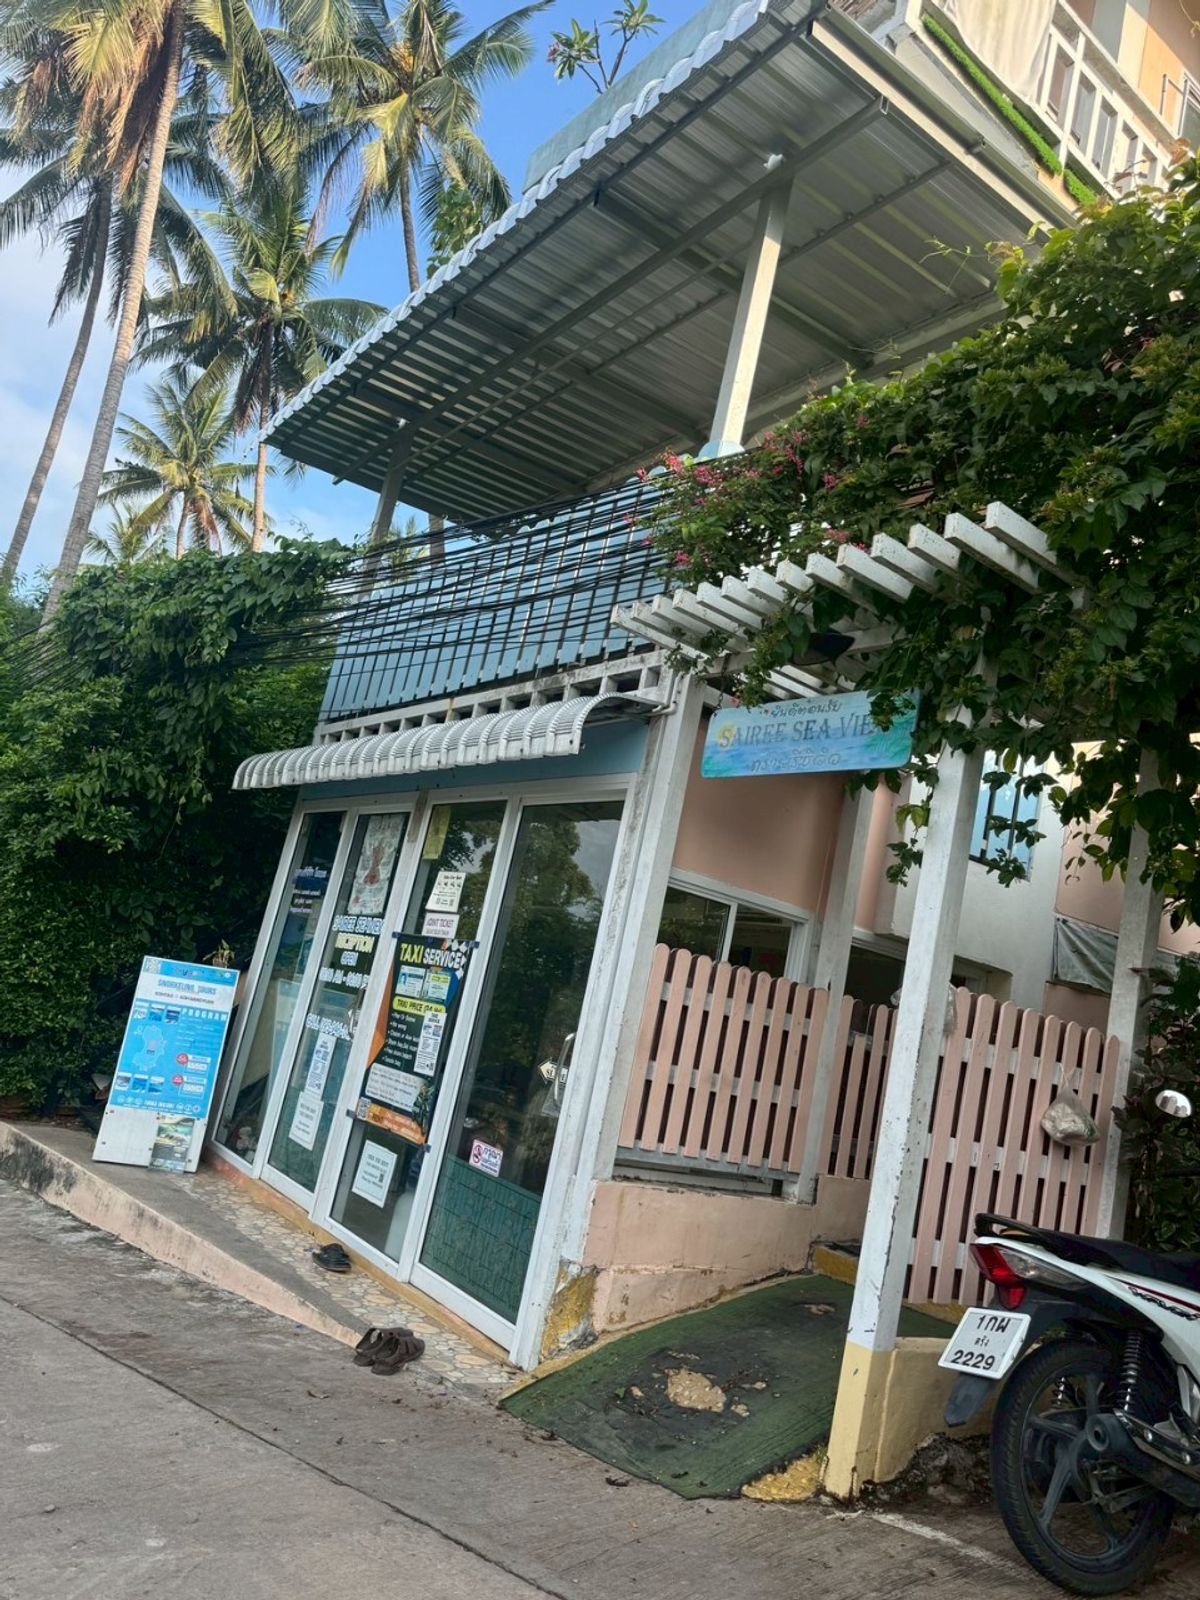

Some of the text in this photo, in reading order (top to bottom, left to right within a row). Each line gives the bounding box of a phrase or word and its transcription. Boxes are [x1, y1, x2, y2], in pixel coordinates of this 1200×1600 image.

[719, 711, 875, 748] SAIREE SEA VIE
[400, 943, 463, 969] TAXI SERVICE
[950, 1349, 996, 1370] 2229
